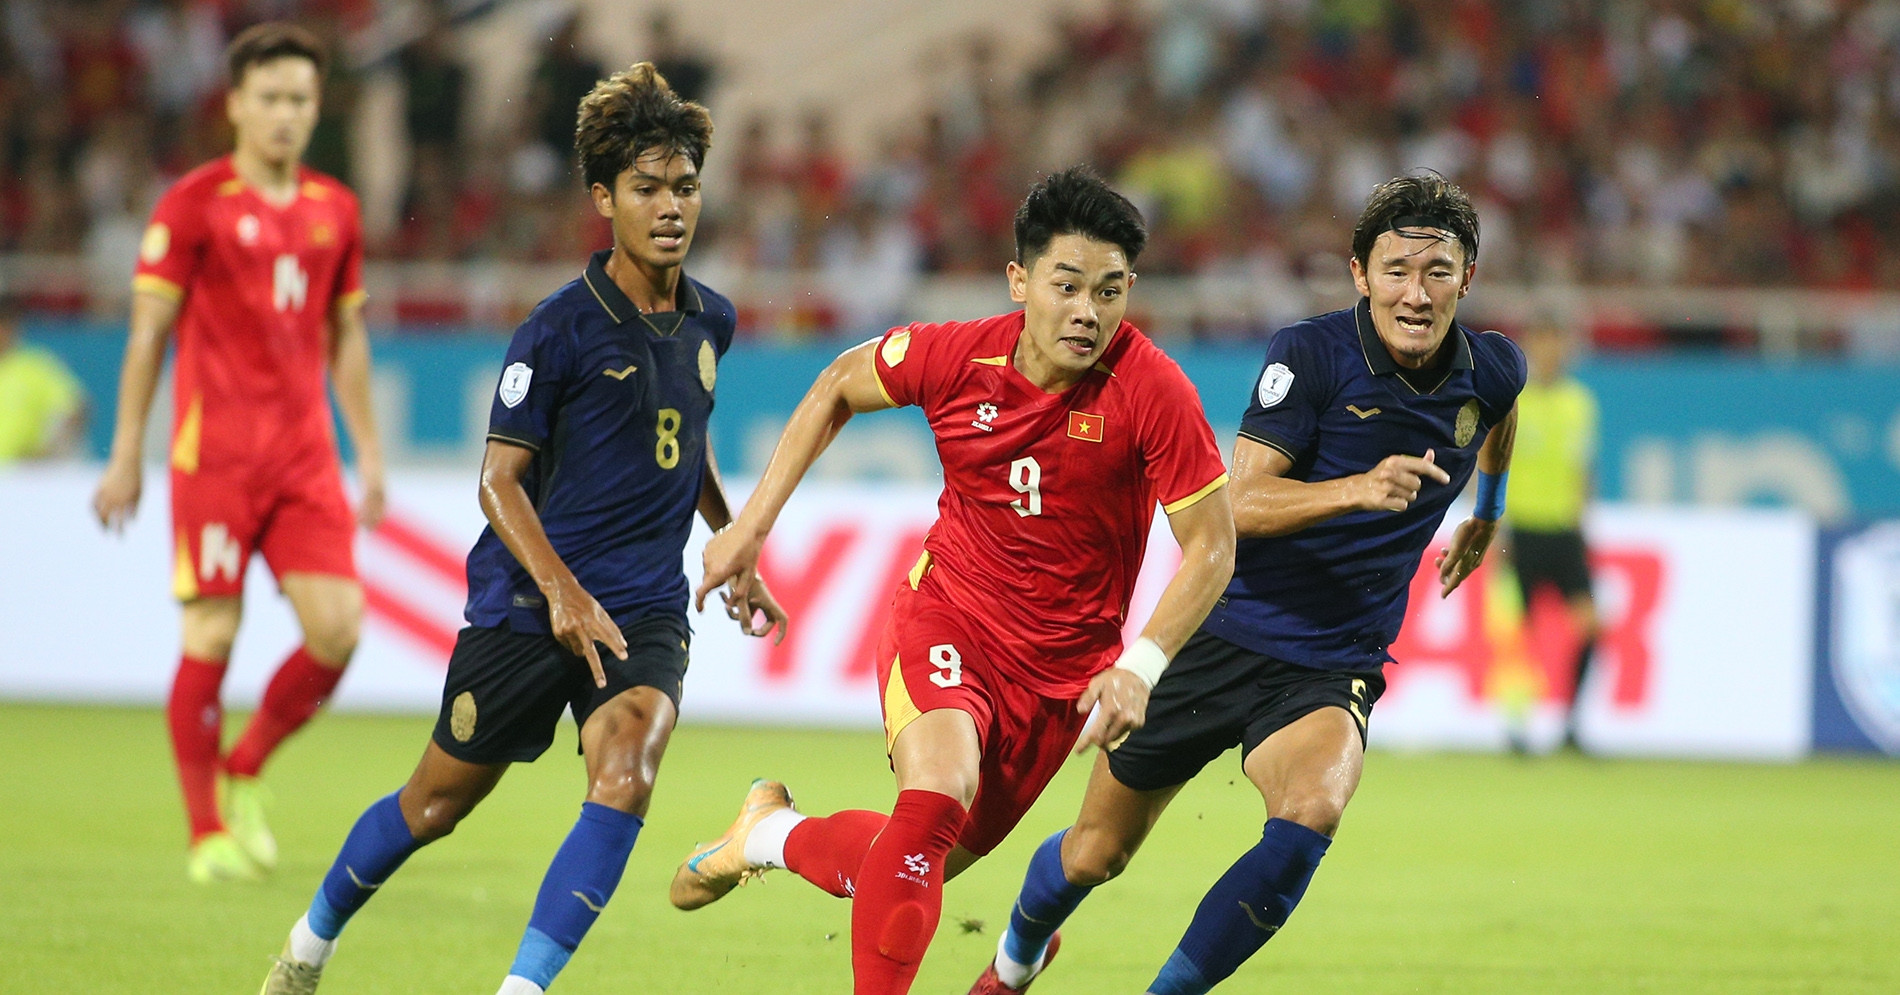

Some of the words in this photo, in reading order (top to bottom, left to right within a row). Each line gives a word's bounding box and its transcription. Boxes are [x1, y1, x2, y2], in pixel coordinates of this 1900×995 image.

[656, 408, 681, 469] 8
[1009, 456, 1042, 518] 9
[929, 643, 962, 688] 9
